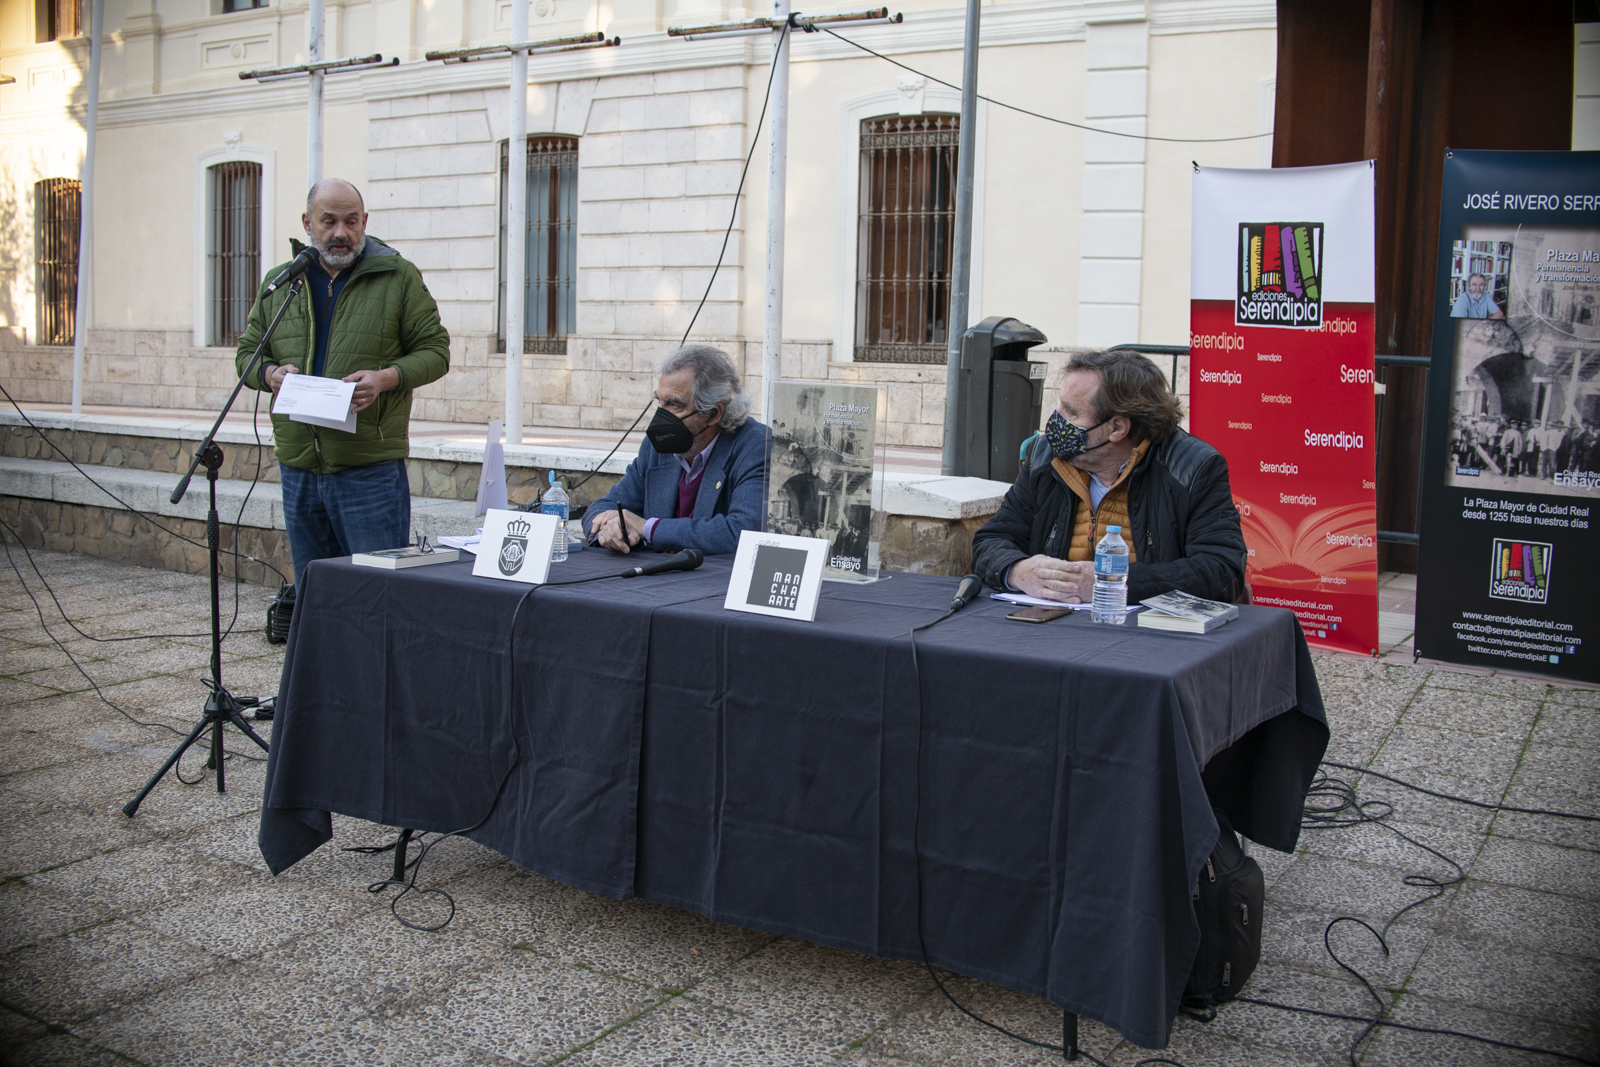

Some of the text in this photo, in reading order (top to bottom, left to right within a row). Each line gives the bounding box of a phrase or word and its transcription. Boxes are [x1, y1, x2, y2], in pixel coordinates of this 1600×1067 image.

[1463, 191, 1500, 209] JOSÉ
[1504, 194, 1559, 210] RIVERO
[1547, 249, 1600, 264] Plaza Ma
[1537, 262, 1590, 273] Permanencia
[1536, 273, 1600, 283] y transformació
[1252, 290, 1287, 301] ediciones
[1240, 296, 1318, 326] Serendipia
[1305, 317, 1356, 336] endipia
[1257, 353, 1282, 362] Serendipia
[1200, 369, 1242, 386] Serendipia
[1340, 364, 1375, 384] Seren
[1261, 393, 1292, 405] Serendipia
[829, 402, 870, 415] Plaza Mayor
[1228, 420, 1252, 431] Serendipia
[1304, 429, 1363, 451] Serendipia
[1260, 461, 1298, 476] Serendipia
[1456, 467, 1480, 476] Serendipia
[1563, 469, 1588, 478] Ciudad
[1280, 493, 1316, 508] Serendipia
[1463, 497, 1589, 517] La Plaza Mayor de Ciudad Real
[1462, 509, 1589, 529] desde 1255 hasta nuestros días
[759, 539, 780, 547] cultura
[1326, 531, 1373, 549] Serendipia
[749, 544, 759, 570] ciencia
[830, 557, 861, 571] Ensayo
[1321, 575, 1346, 585] Serendipia
[1501, 579, 1525, 587] ediciones
[770, 583, 798, 596] CHA
[1493, 581, 1544, 600] Serendipia
[768, 594, 796, 608] ARTE
[1253, 595, 1334, 611] .serendipiaeditorial.com
[1462, 611, 1573, 631] www.serendipiaeditorial.com
[1452, 622, 1582, 645] contacto@serendipiaeditorial.com
[1457, 632, 1564, 653] facebook.com/serendipiaeditorial
[1468, 644, 1548, 662] twitter.com/SerendipiaE
